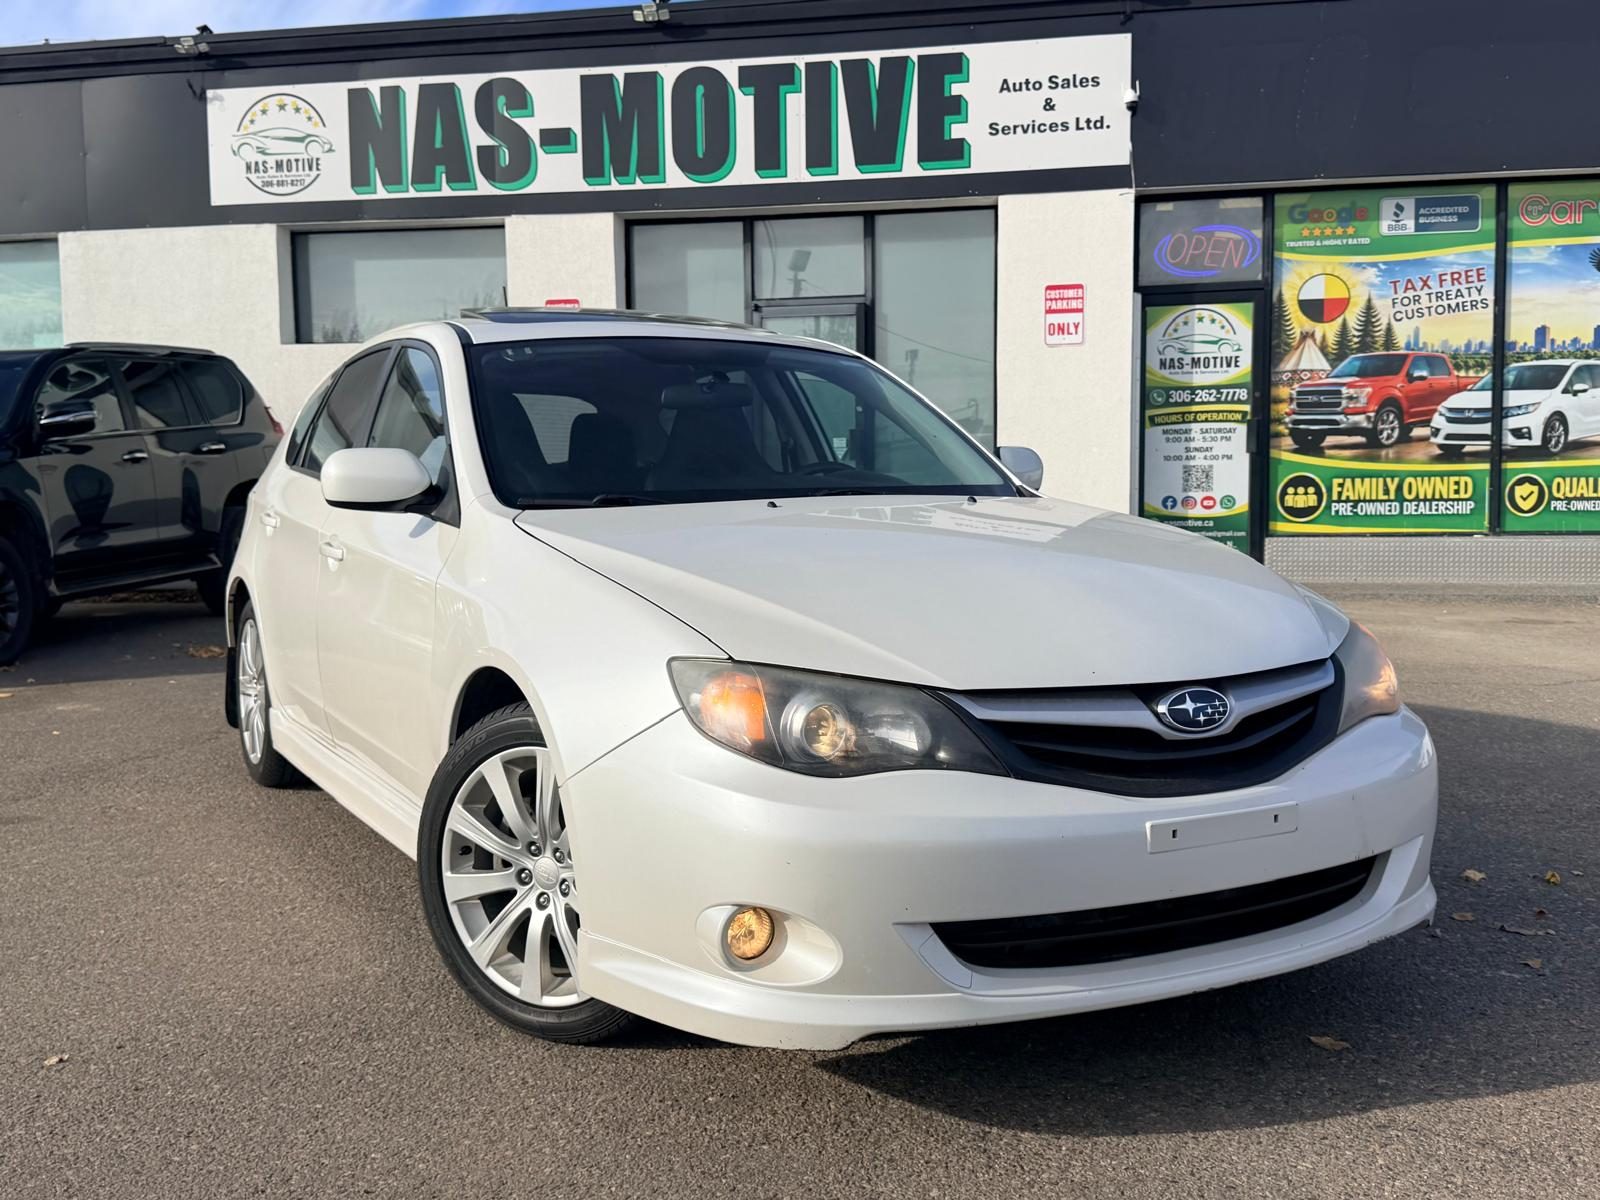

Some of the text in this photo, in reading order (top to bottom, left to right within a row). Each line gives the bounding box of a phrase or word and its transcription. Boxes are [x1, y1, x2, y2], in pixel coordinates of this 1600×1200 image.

[999, 74, 1100, 93] Auto Sales
[1043, 97, 1056, 111] &
[347, 52, 971, 195] NAS-MOTIVE
[988, 116, 1111, 136] Services Ltd.
[246, 157, 321, 174] NAS-MOTIVE
[1418, 206, 1470, 214] ACCREDITED
[1418, 215, 1459, 223] BUSINESS
[1387, 223, 1408, 232] BBB
[1166, 233, 1246, 269] OPEN
[1389, 267, 1487, 295] TAX FREE
[1046, 289, 1084, 299] CUSTOMER
[1392, 285, 1484, 309] FOR TREATY
[1046, 299, 1084, 310] PARKING
[1393, 298, 1490, 323] CUSTOMERS
[1048, 322, 1080, 336] ONLY
[1159, 355, 1241, 371] NAS-MOTIVE
[1169, 388, 1248, 403] 306-262-7778
[1154, 411, 1243, 424] HOURS OF OPERATION
[1199, 427, 1237, 435] SATURDAY
[1332, 475, 1473, 501] FAMILY OWNED
[1331, 500, 1475, 516] PRE-OWNED DEALERSHIP
